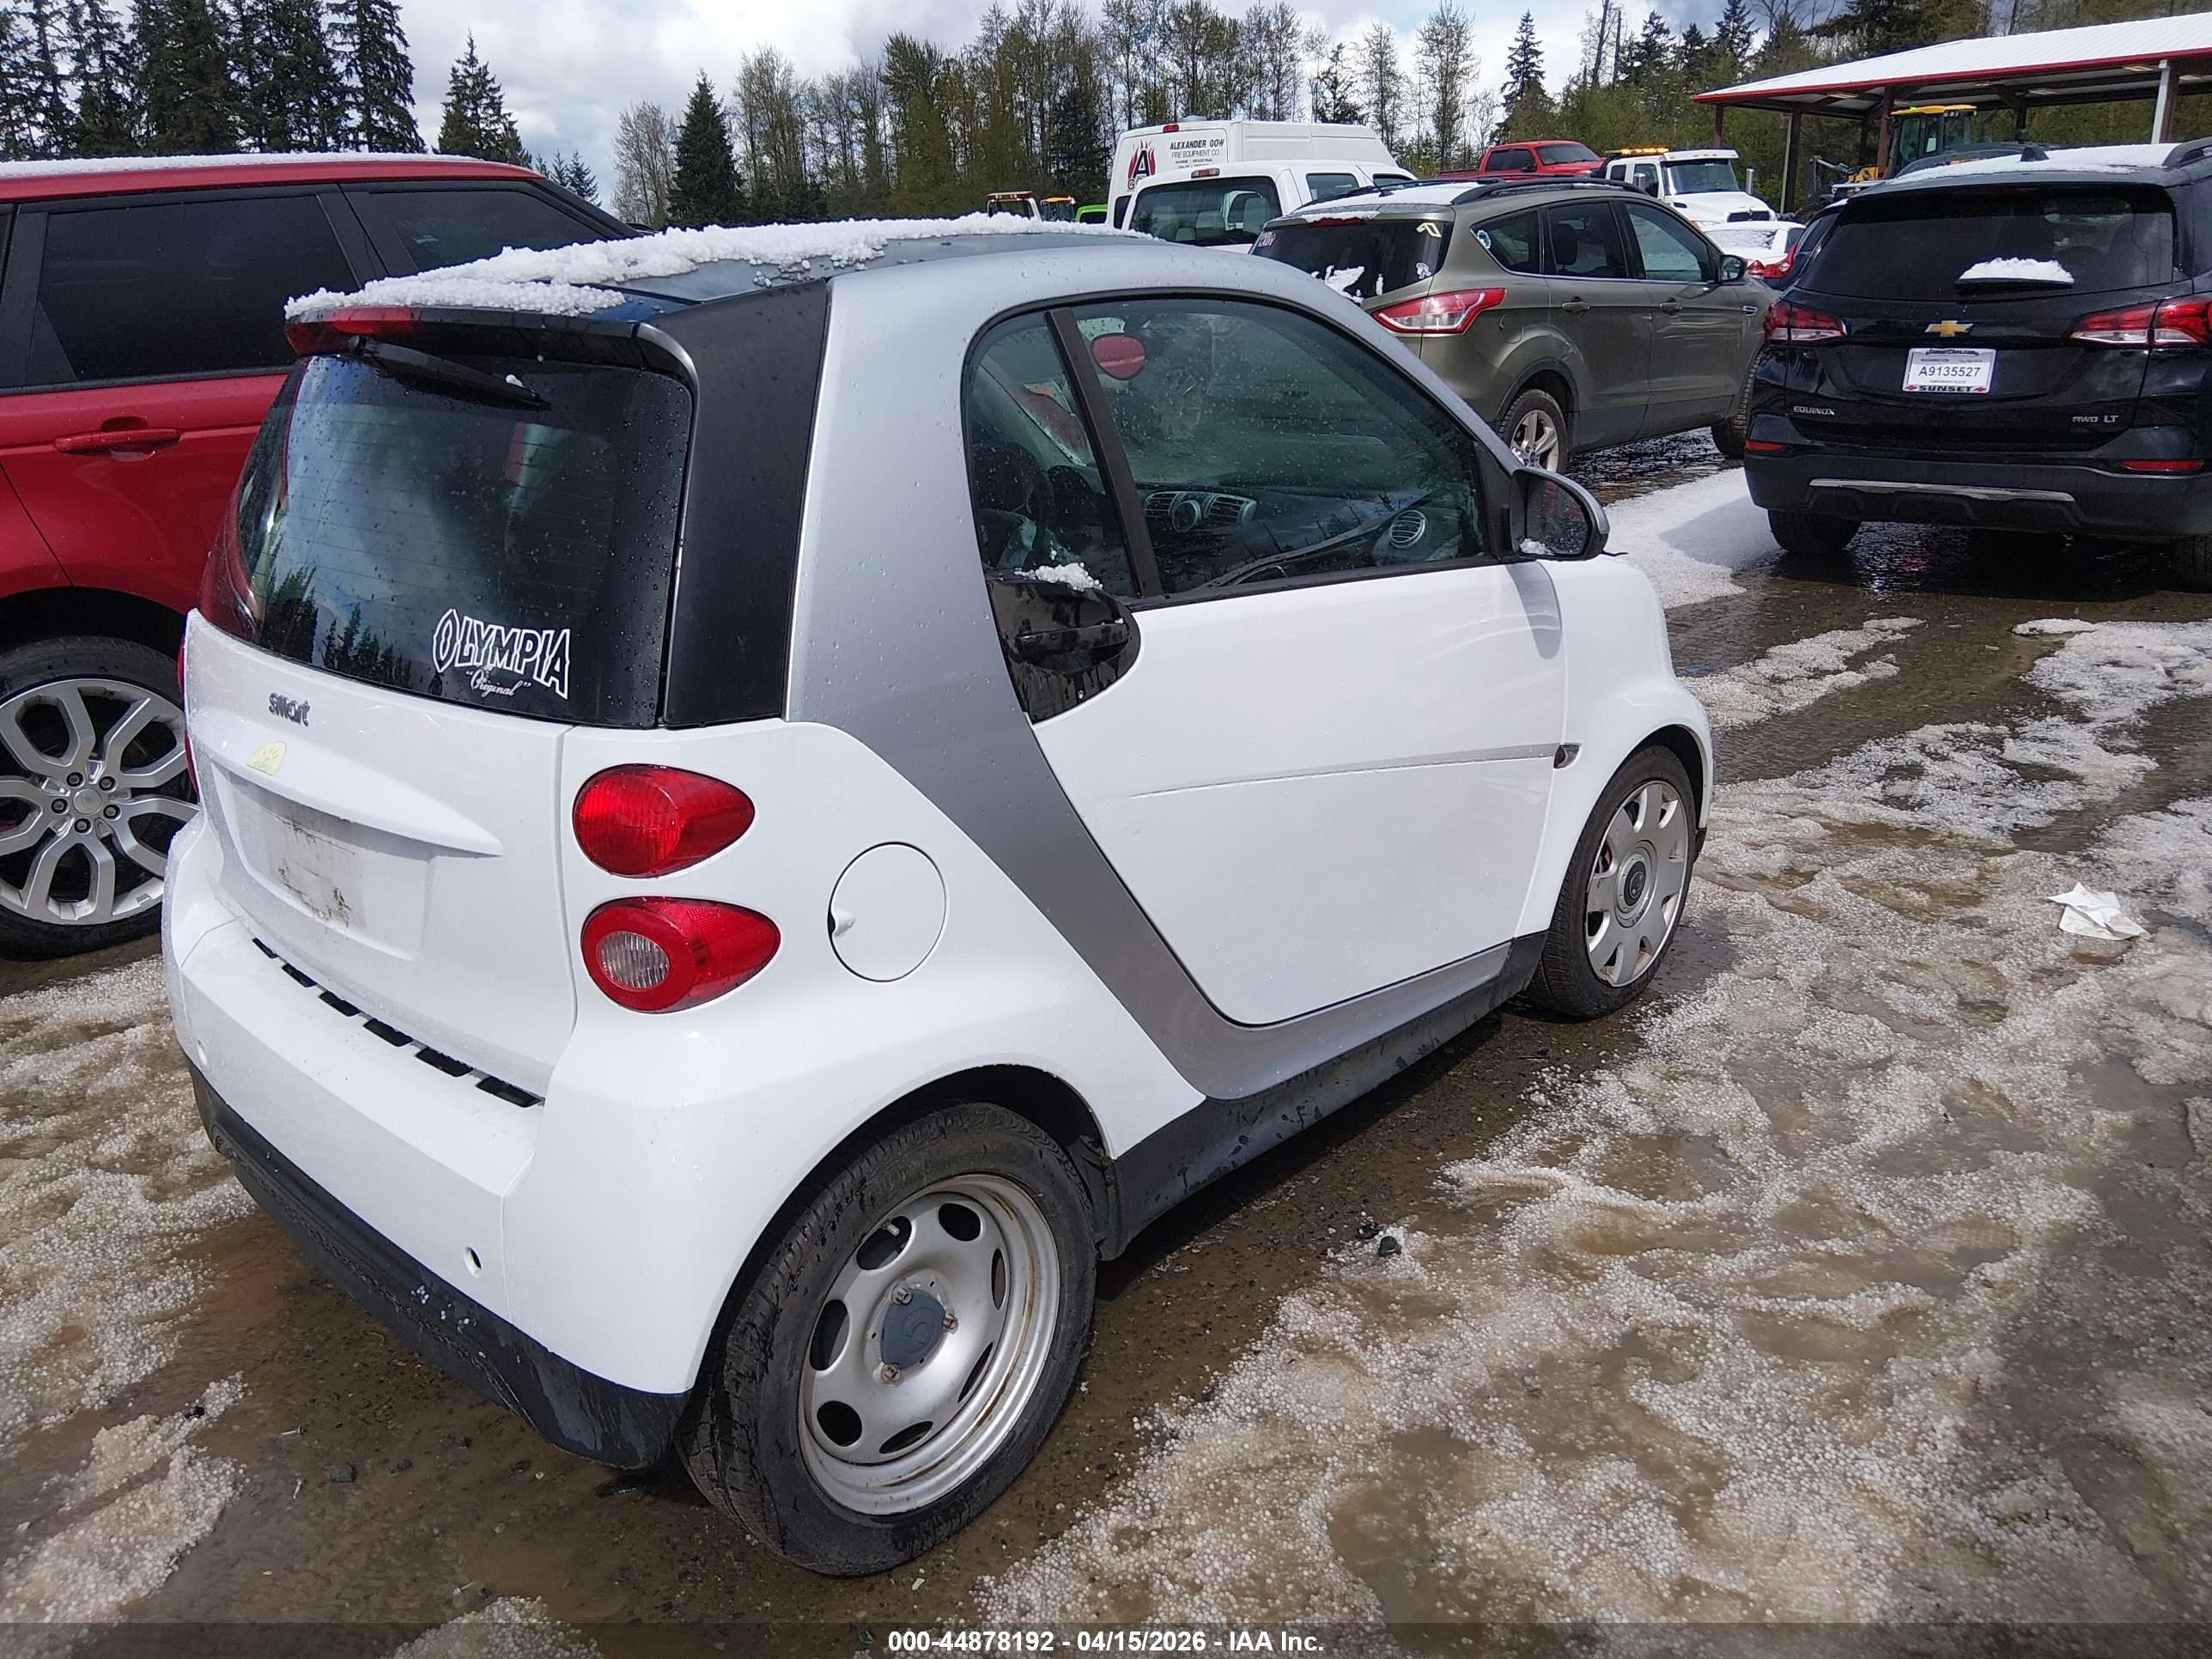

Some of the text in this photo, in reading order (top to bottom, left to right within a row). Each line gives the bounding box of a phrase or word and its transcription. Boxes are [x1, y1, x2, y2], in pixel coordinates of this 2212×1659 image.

[1170, 138, 1225, 150] ALEXANDER GOW
[1182, 149, 1211, 158] EQUIPMENT
[1918, 366, 1981, 377] A9135527
[1794, 405, 1835, 416] EQUINOX
[433, 609, 570, 700] OLYMPIA
[268, 692, 311, 727] smart
